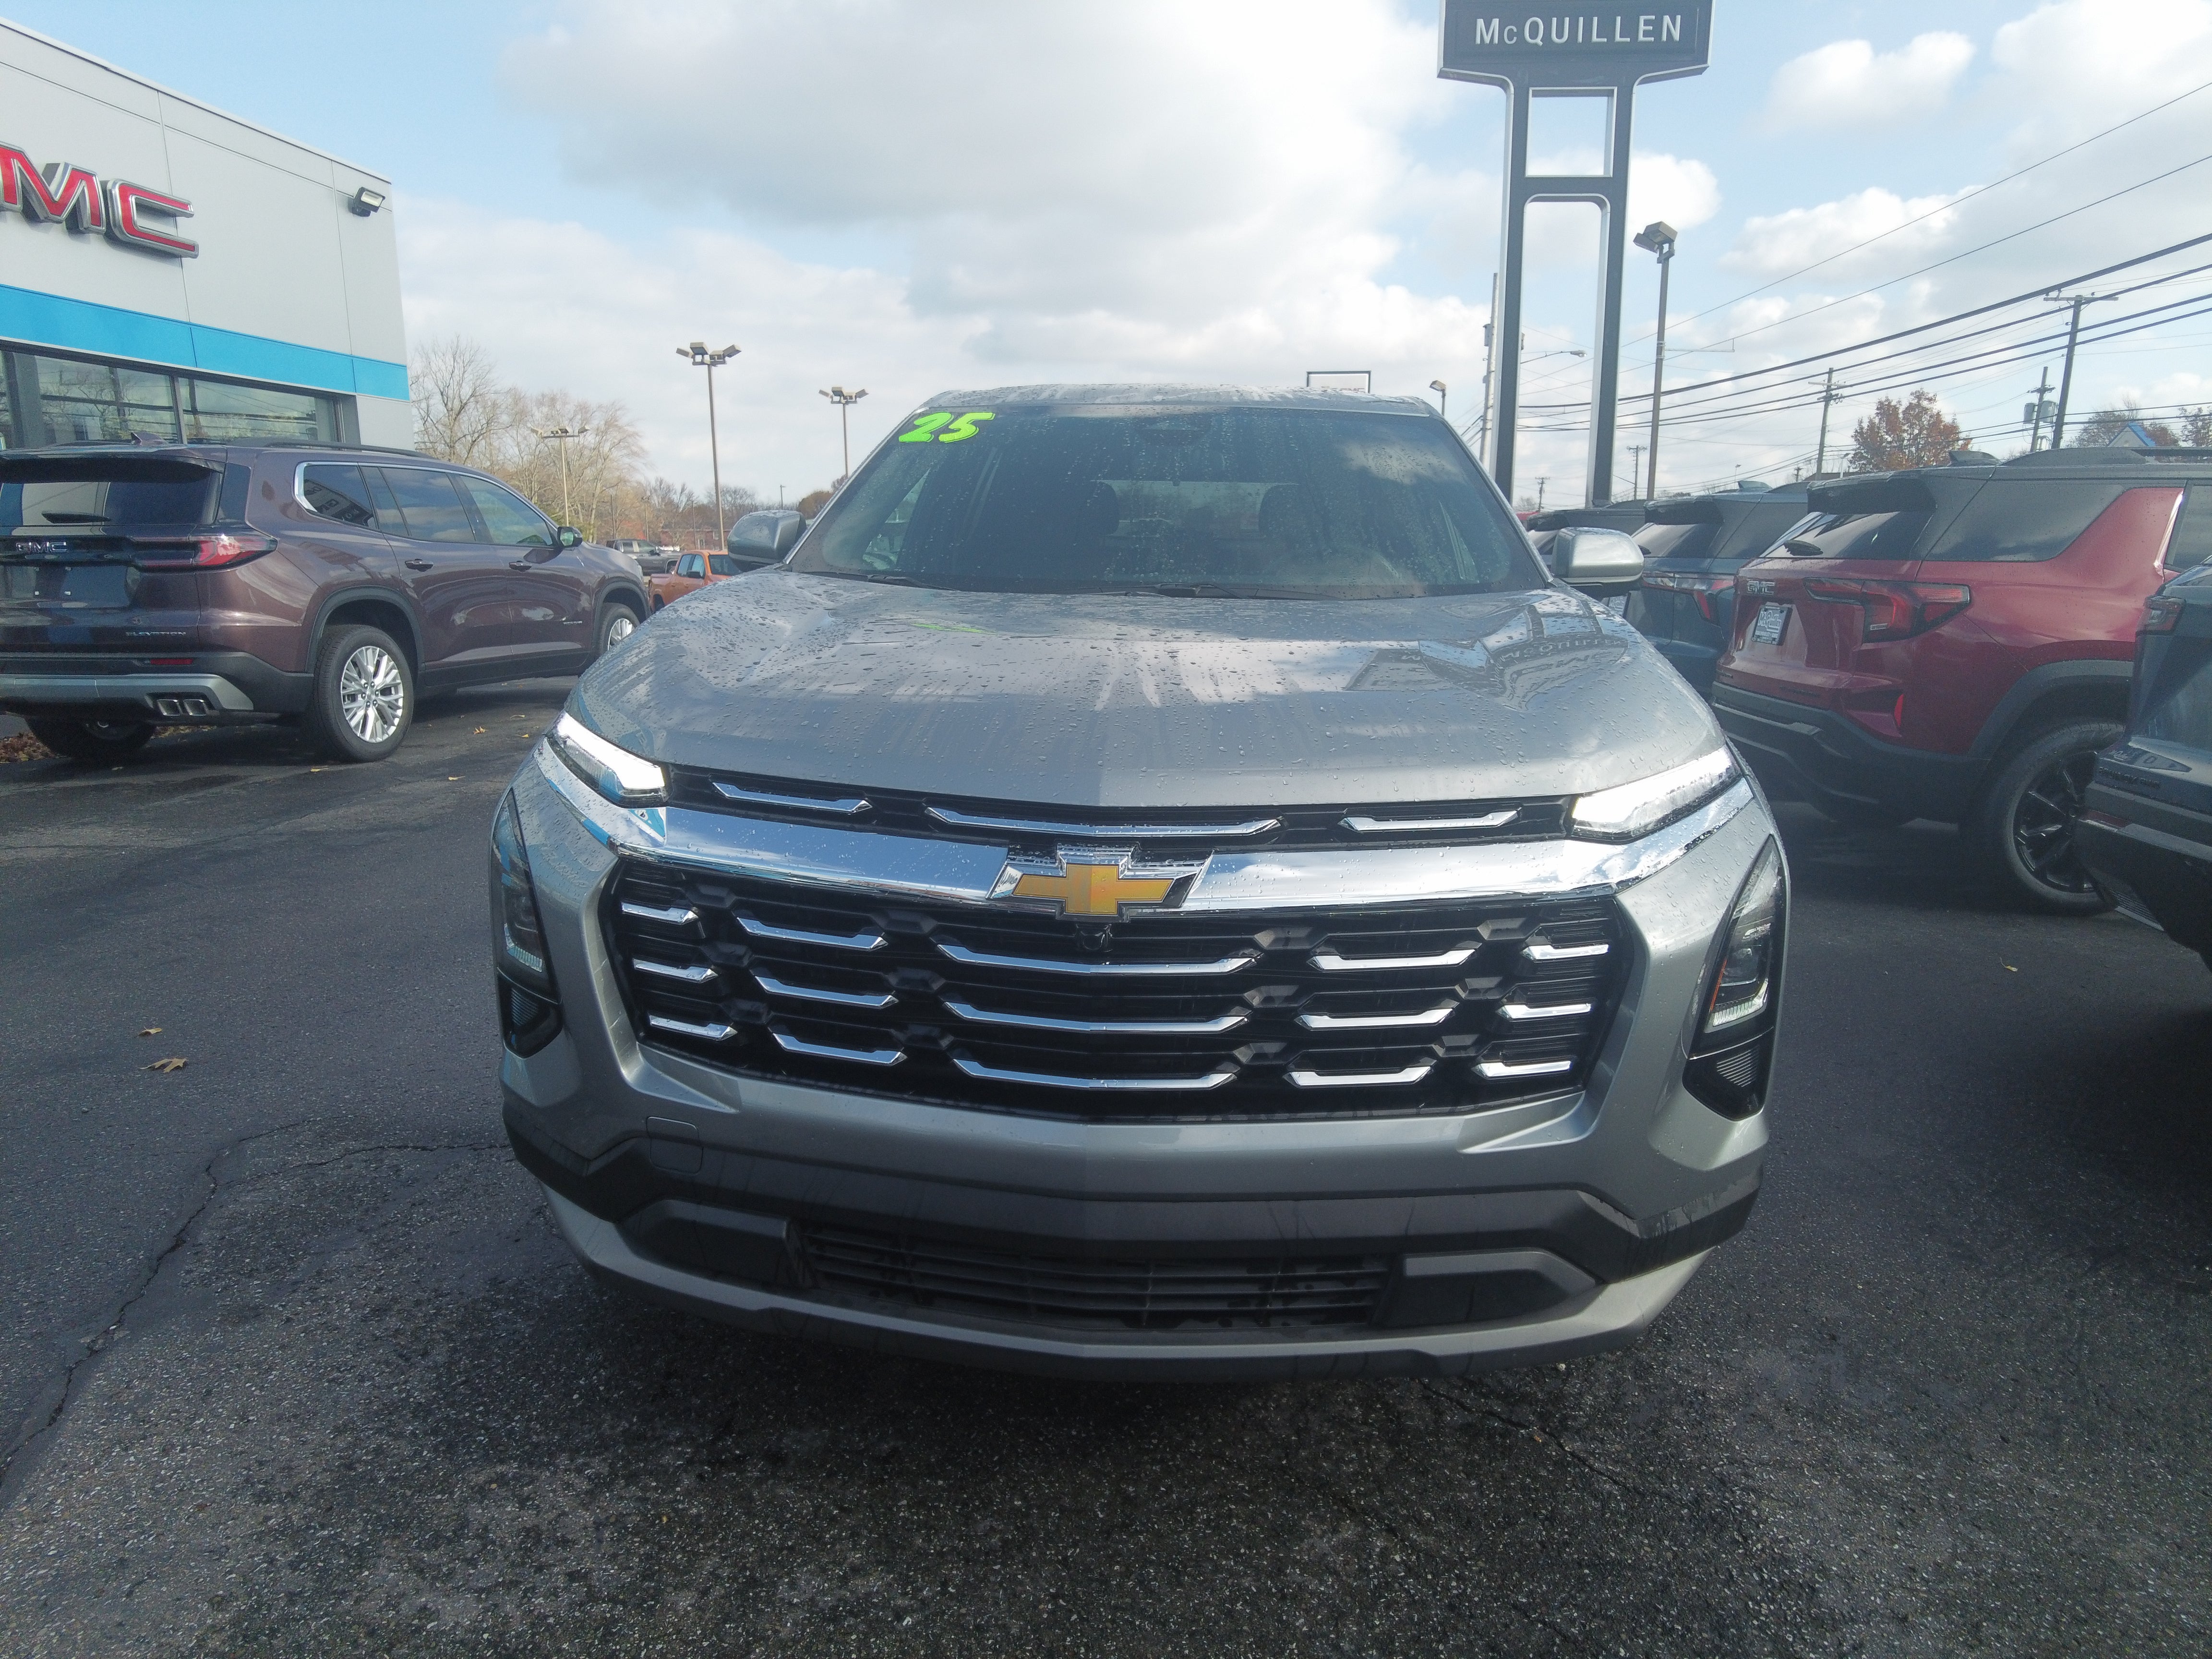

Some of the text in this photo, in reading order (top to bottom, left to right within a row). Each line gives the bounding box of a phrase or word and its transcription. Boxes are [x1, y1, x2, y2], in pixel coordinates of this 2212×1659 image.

[1475, 15, 1681, 47] McQUILLEN
[0, 141, 199, 259] MC
[899, 411, 996, 444] 25
[15, 541, 67, 553] GMC
[1746, 580, 1776, 596] GMC
